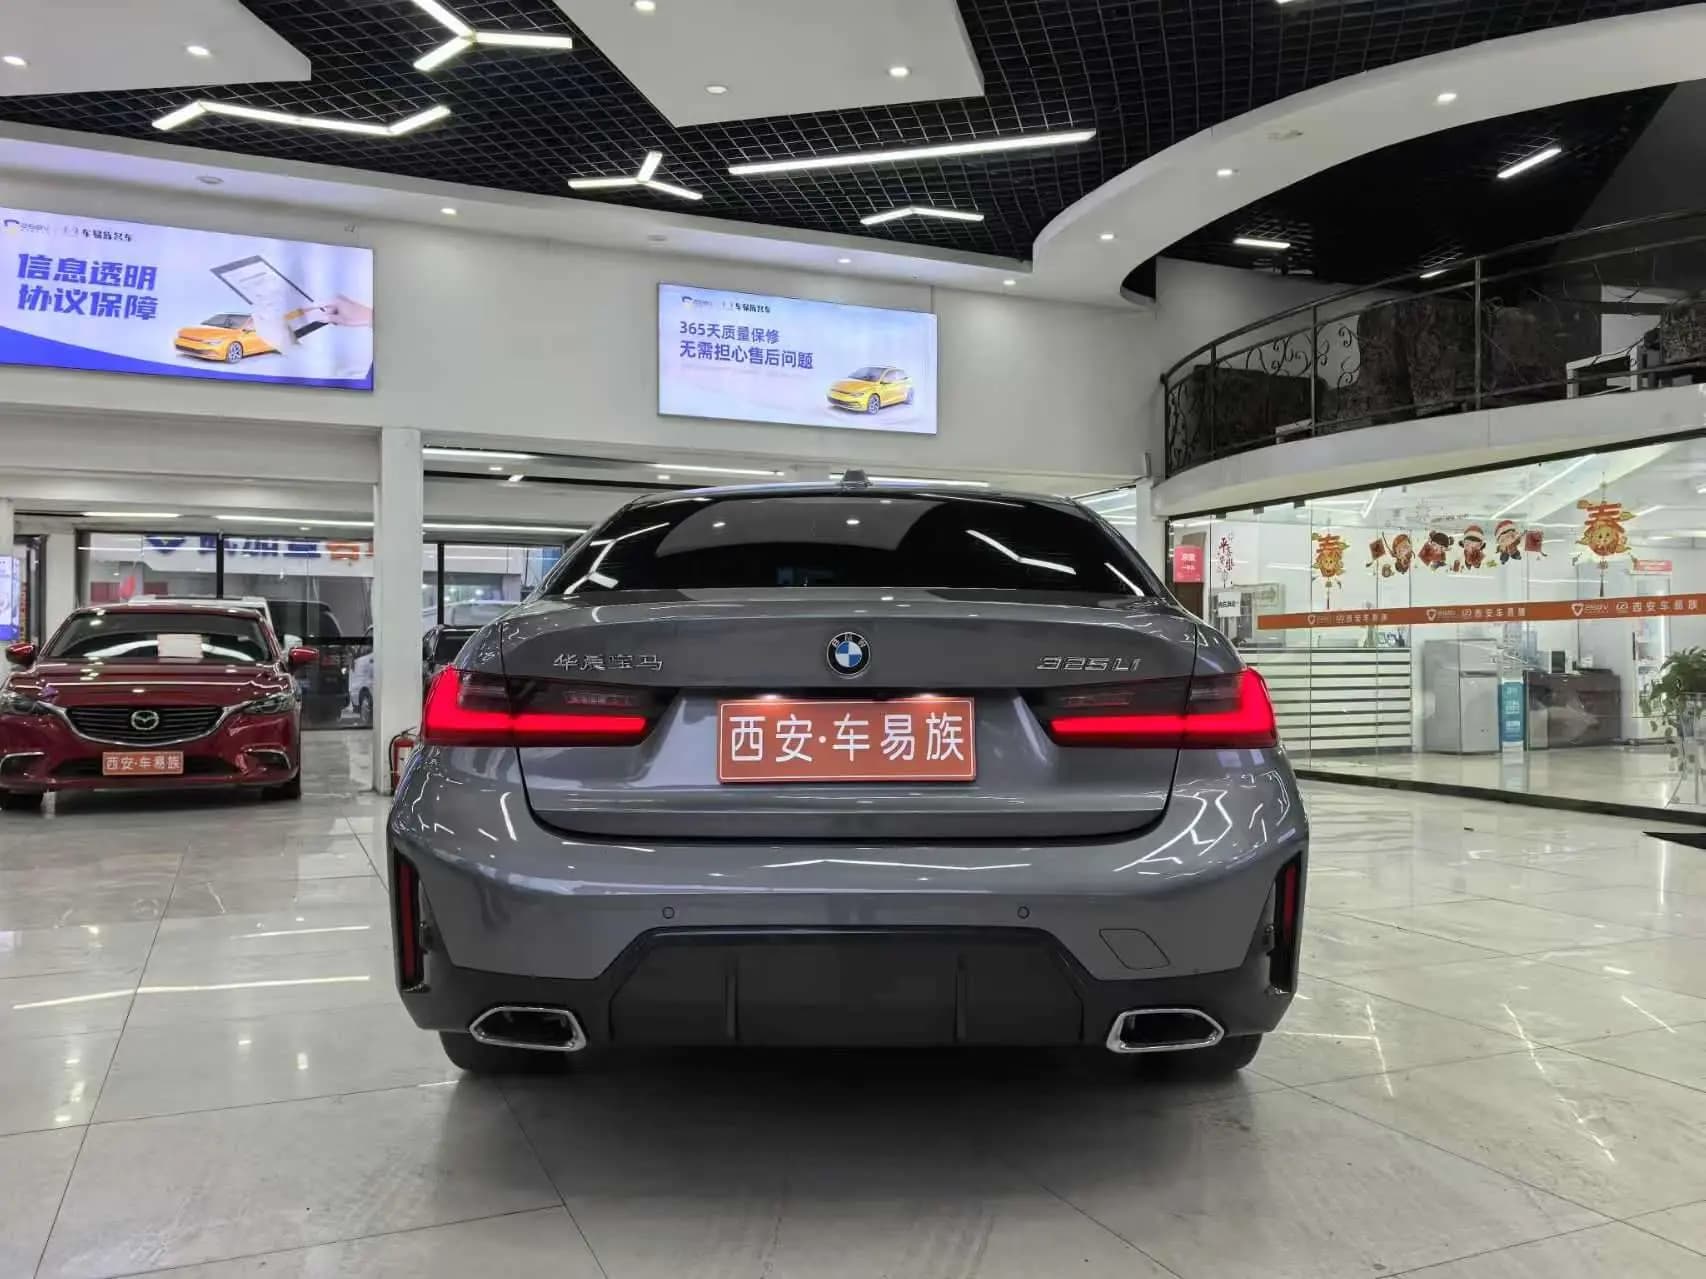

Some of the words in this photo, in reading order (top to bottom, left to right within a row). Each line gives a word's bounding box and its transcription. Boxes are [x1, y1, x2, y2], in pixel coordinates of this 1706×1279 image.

[17, 253, 158, 291] 信息透明
[17, 284, 158, 320] 协议保障
[680, 321, 780, 344] 365天质量保修
[680, 340, 814, 369] 无需担心售后问题
[1632, 599, 1698, 612] 西安车易族
[831, 632, 866, 648] BMW
[729, 712, 964, 762] 西安·车易族
